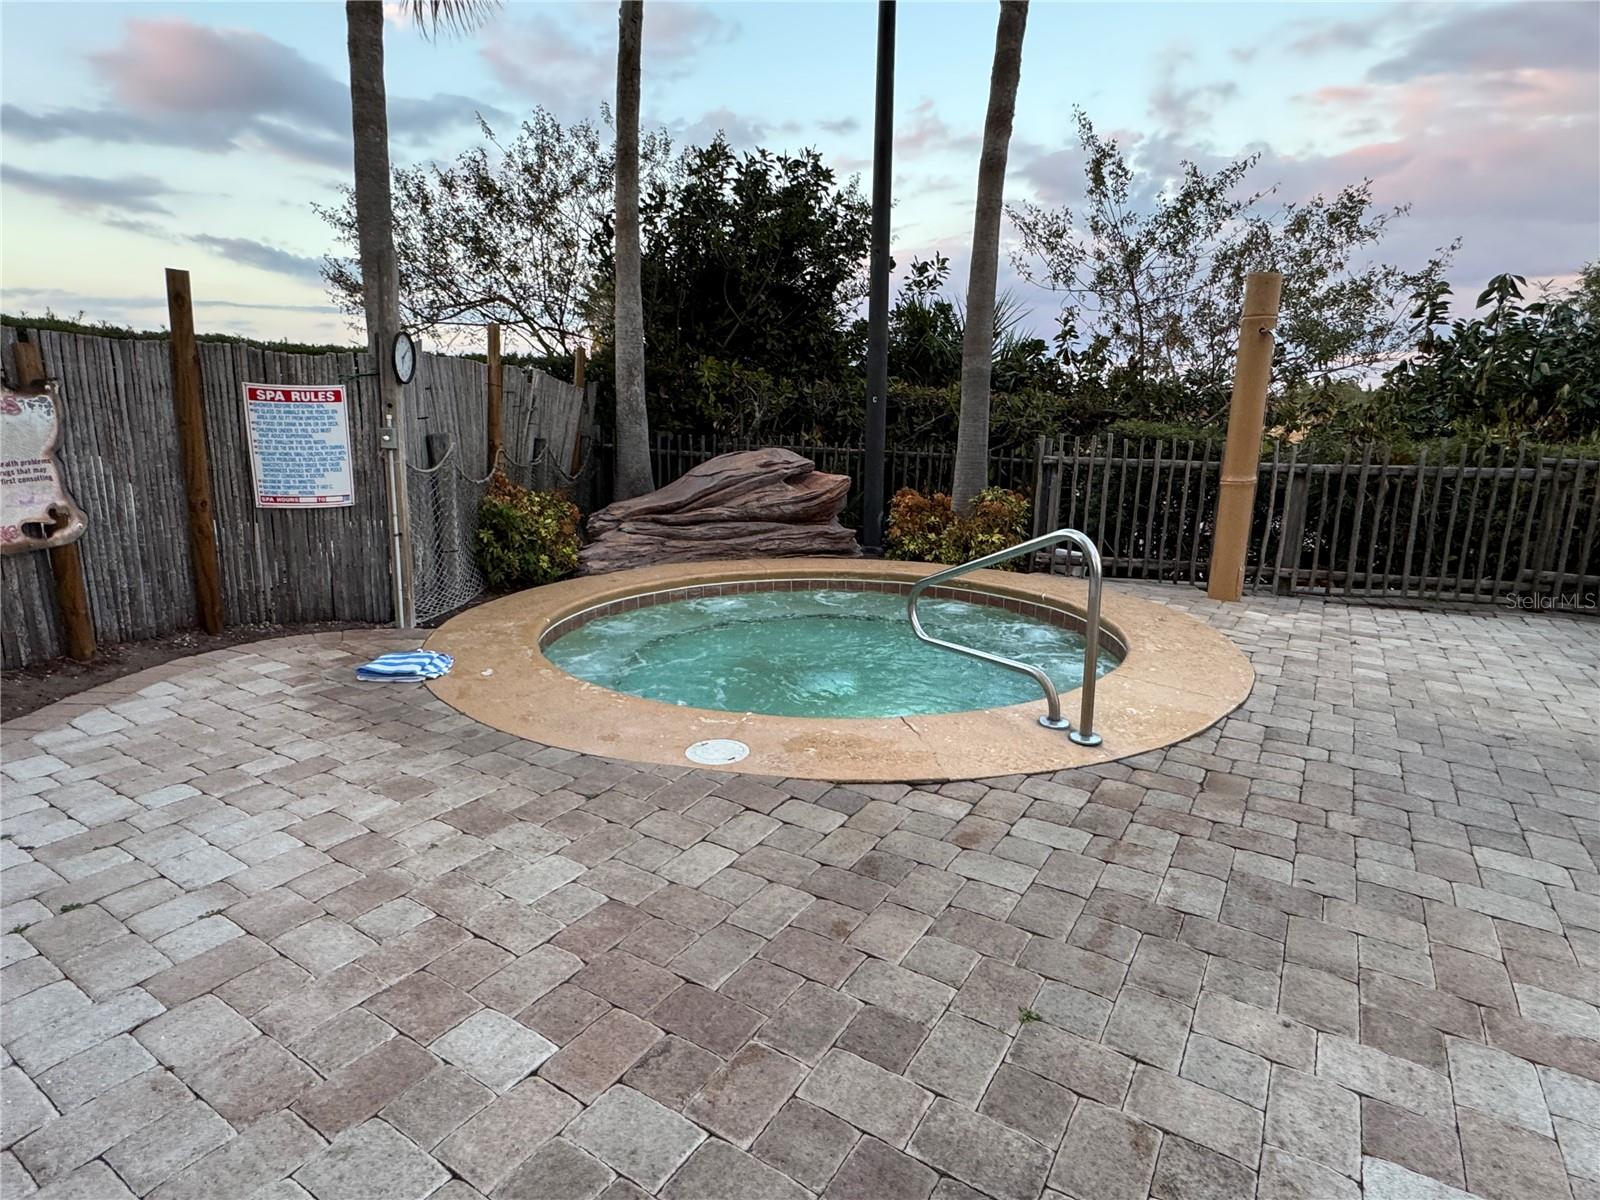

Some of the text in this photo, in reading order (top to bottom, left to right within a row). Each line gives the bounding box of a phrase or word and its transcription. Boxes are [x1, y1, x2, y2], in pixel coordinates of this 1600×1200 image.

[256, 390, 335, 402] SPA RULES
[20, 458, 51, 467] problems
[18, 475, 53, 483] consulting
